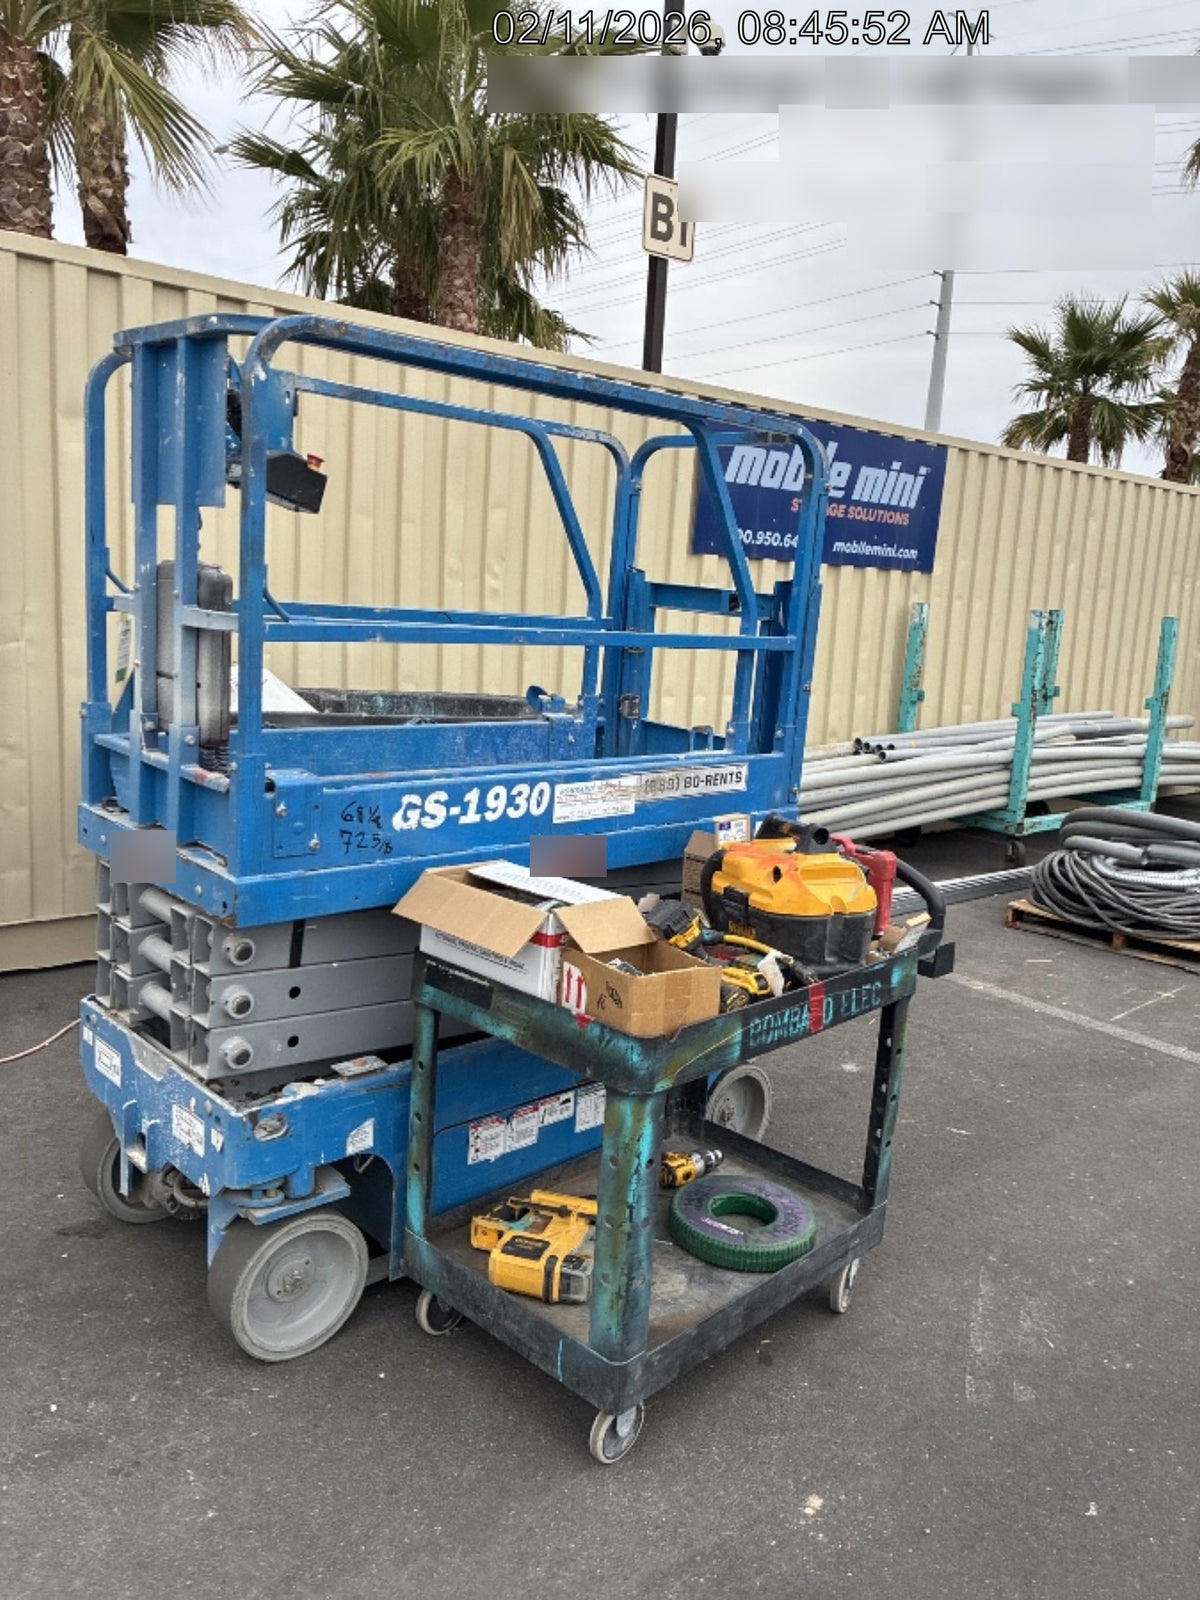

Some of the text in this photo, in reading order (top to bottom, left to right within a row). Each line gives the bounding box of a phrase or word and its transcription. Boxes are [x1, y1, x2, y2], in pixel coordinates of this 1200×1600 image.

[725, 440, 929, 509] moble mini
[848, 505, 910, 526] SOLUTIONS
[832, 540, 918, 560] mobilemini.com
[392, 781, 551, 832] GS-1930
[749, 993, 833, 1047] BOMBAD
